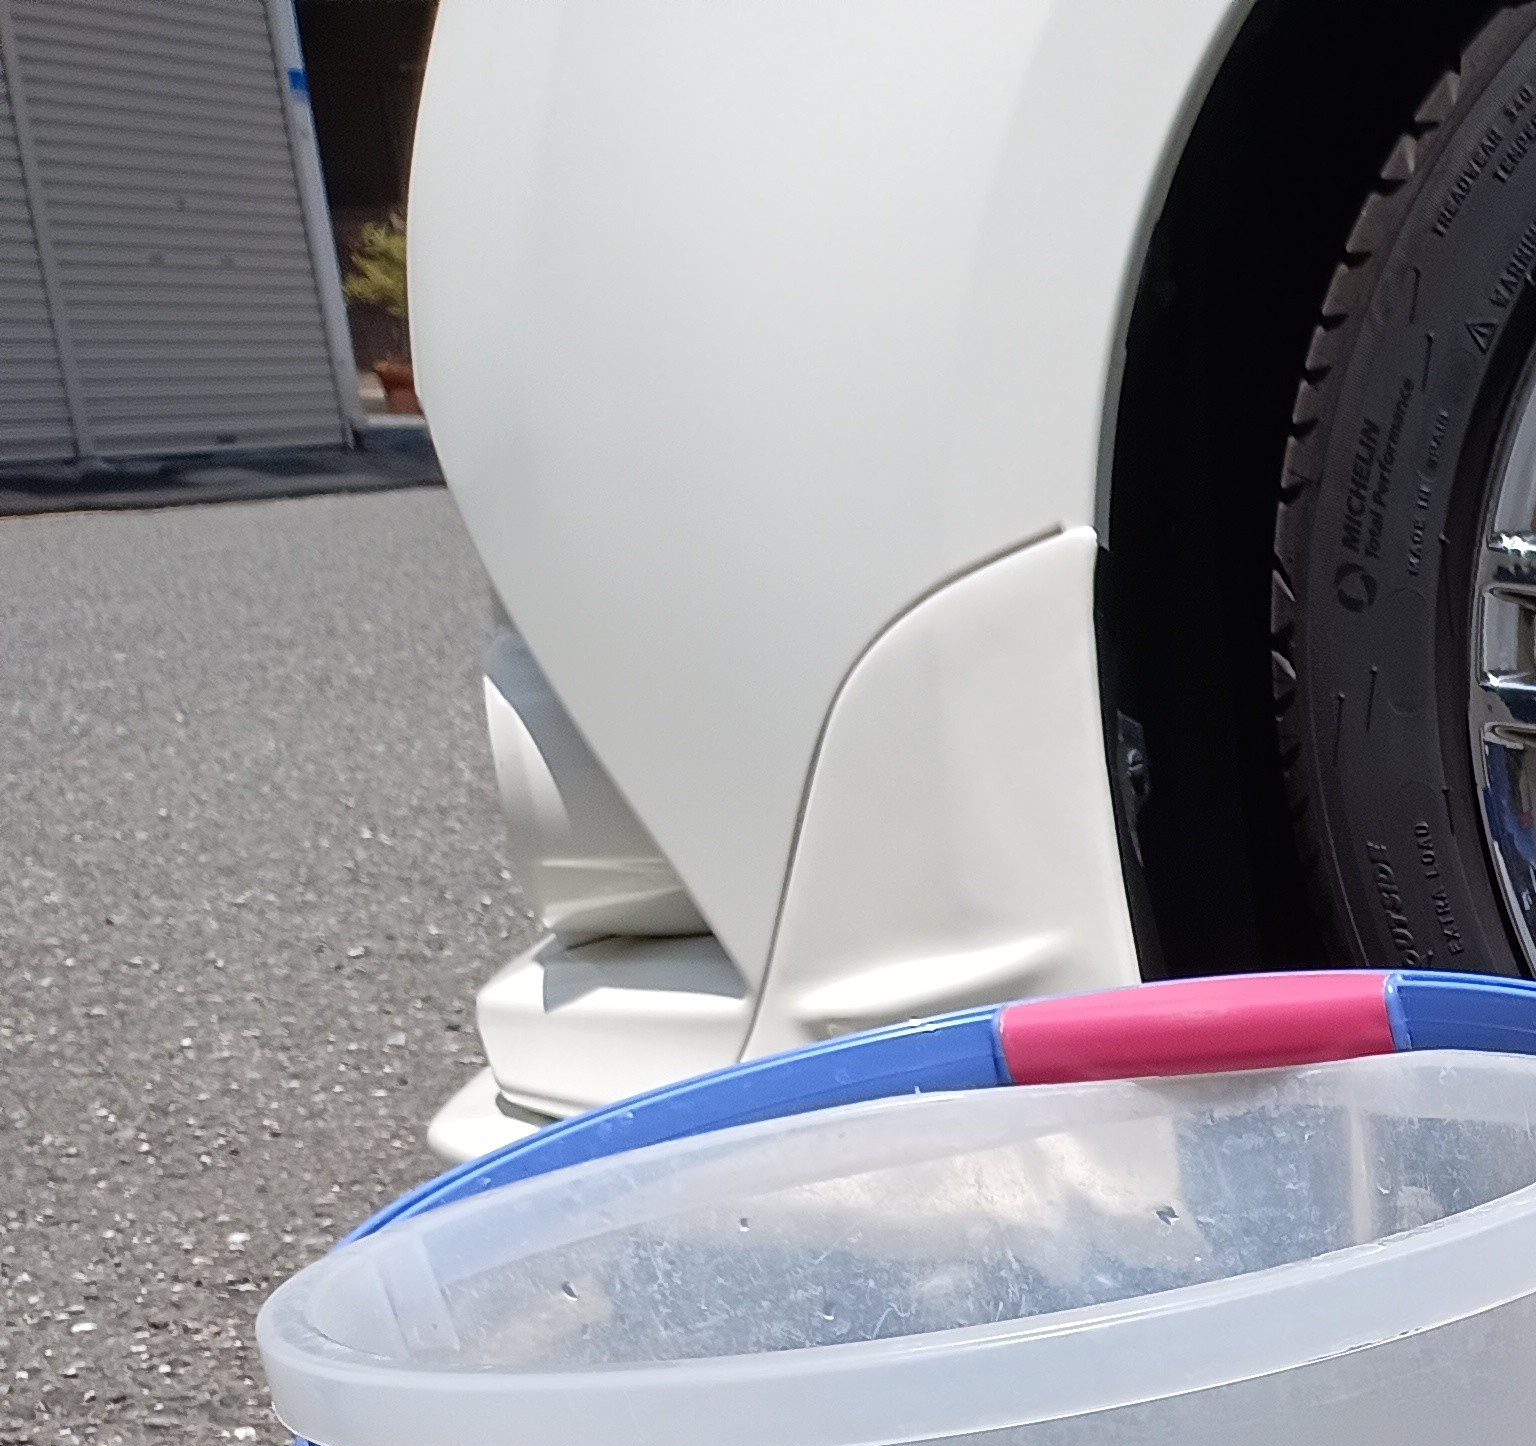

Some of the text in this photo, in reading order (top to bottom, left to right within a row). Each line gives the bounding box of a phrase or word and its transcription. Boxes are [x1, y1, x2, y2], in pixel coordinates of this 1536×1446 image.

[1341, 417, 1380, 554] MICHELIN
[1414, 820, 1464, 955] EXTRA LOAD
